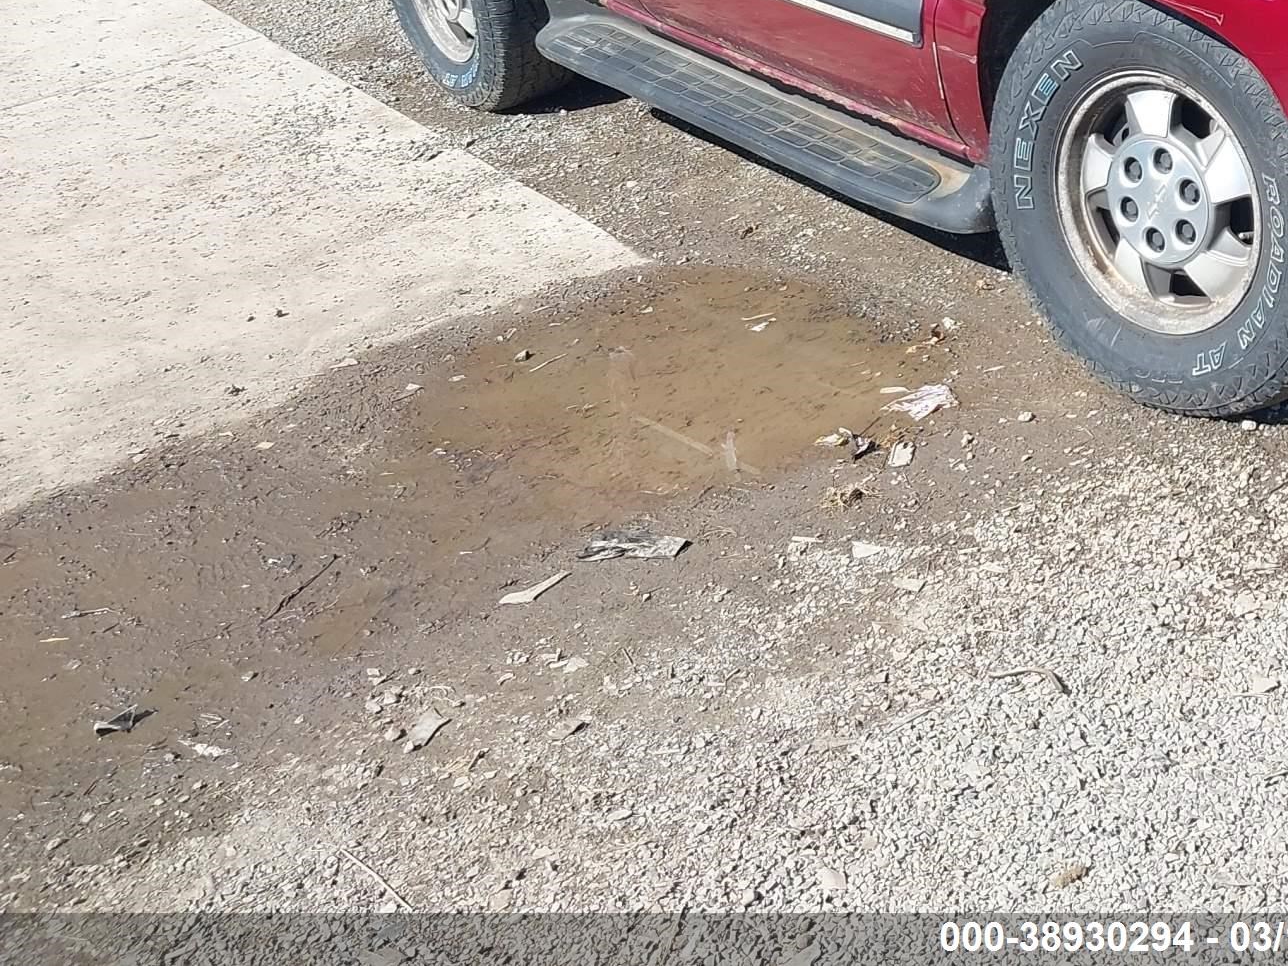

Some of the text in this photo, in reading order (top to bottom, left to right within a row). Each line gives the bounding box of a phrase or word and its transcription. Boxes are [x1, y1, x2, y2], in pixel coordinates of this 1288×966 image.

[1013, 49, 1084, 210] NEXEN
[1192, 173, 1286, 377] ROADIAN AT
